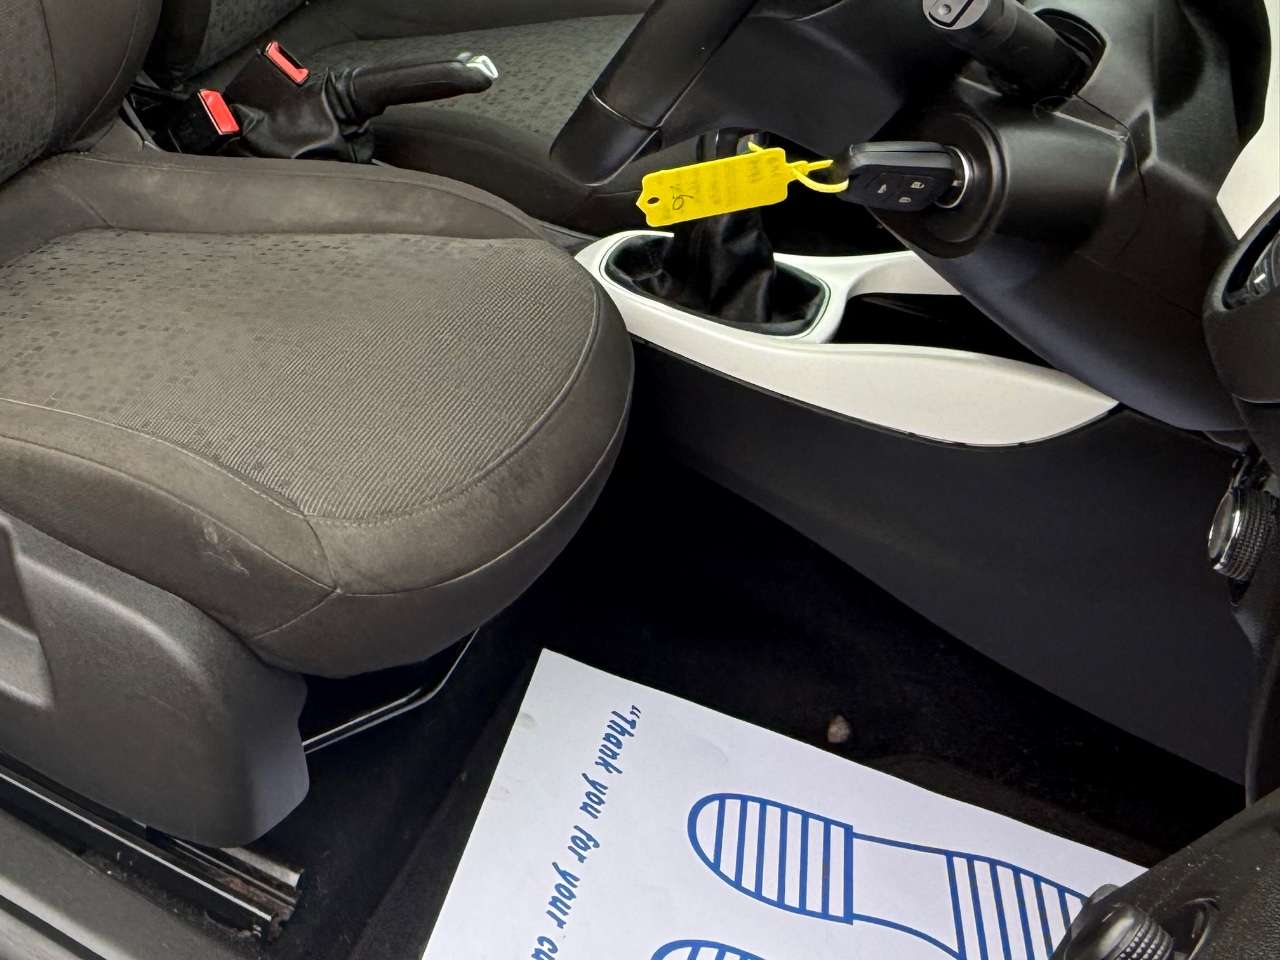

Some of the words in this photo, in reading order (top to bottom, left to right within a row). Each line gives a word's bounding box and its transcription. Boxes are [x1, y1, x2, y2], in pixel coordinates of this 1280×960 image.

[579, 773, 608, 819] you
[568, 825, 601, 863] for
[546, 862, 579, 929] your
